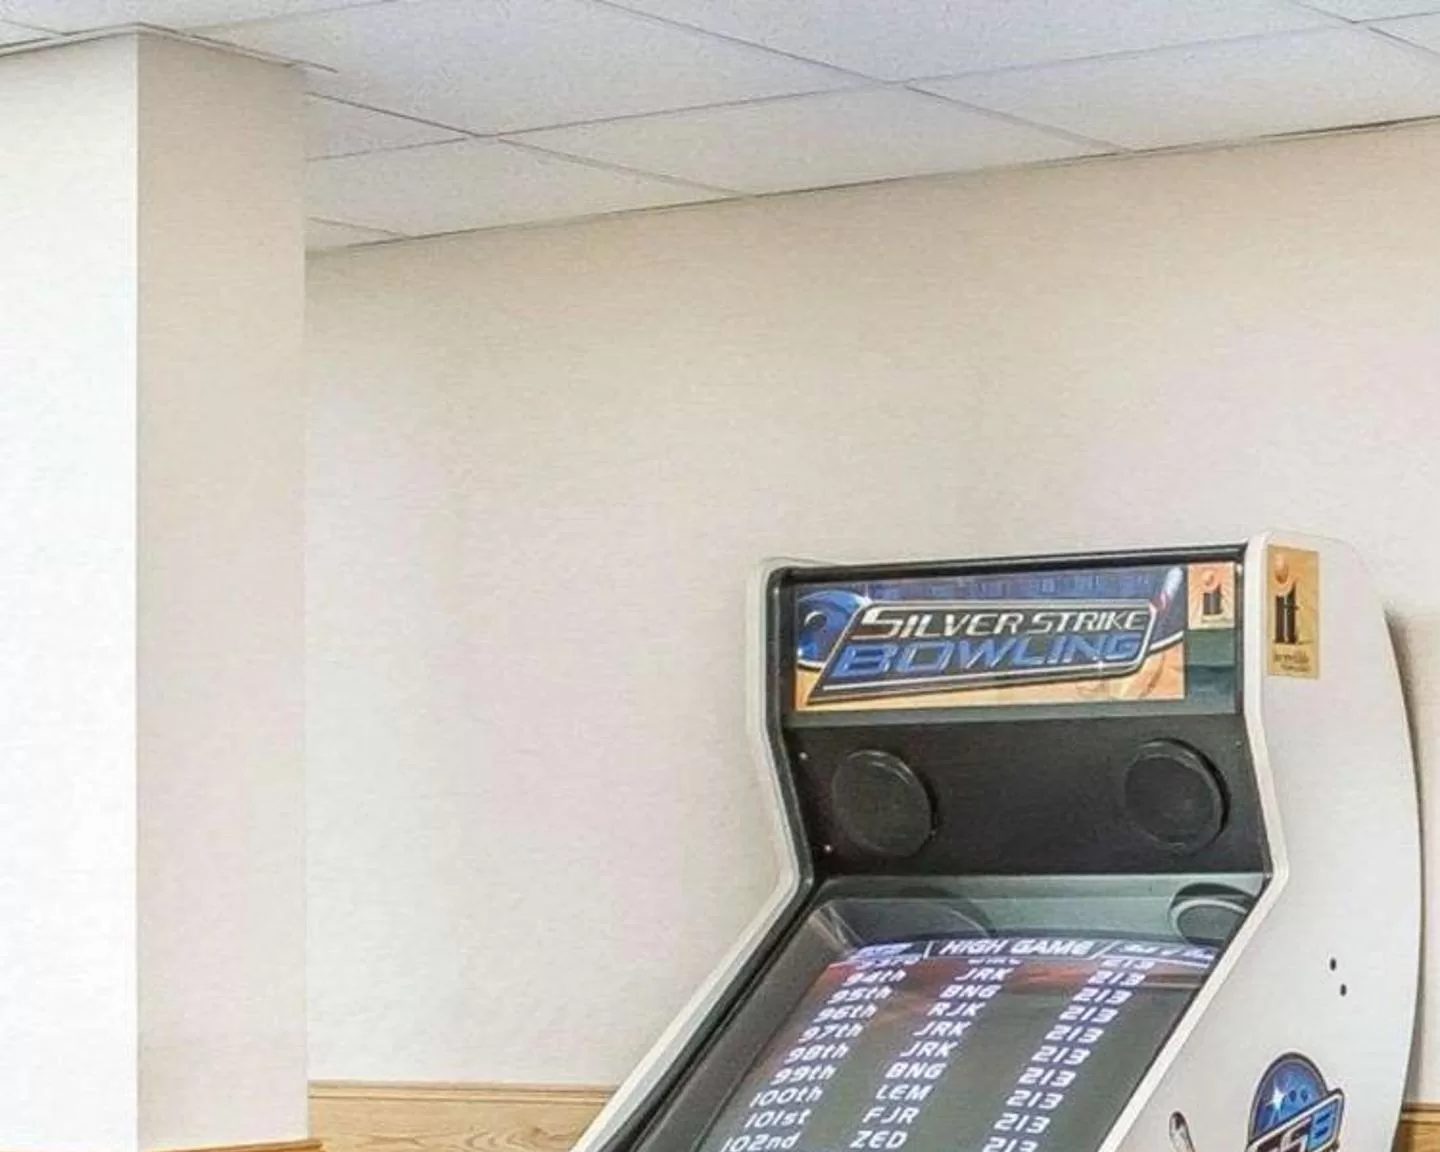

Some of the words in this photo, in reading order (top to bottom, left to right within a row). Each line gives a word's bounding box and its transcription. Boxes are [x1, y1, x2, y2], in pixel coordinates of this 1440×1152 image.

[851, 604, 1026, 640] SILVER
[1027, 610, 1148, 635] STRIKE
[830, 632, 1144, 680] BOWLING
[939, 939, 1009, 955] HIGH
[1010, 939, 1095, 955] GAME
[954, 967, 1014, 981] JRK
[1087, 969, 1146, 986] 213
[939, 984, 1002, 999] BNG
[1071, 987, 1133, 1005] 213
[812, 1003, 878, 1023] 96th
[926, 1001, 986, 1017] RJK
[1058, 1004, 1119, 1023] 213
[797, 1022, 863, 1043] 97th
[912, 1020, 972, 1037] JRK
[1043, 1023, 1104, 1044] 213
[783, 1041, 849, 1064] 98th
[899, 1040, 959, 1057] JRK
[1030, 1045, 1091, 1066] 213
[769, 1064, 837, 1086] 99th
[884, 1061, 948, 1079] BNG
[1017, 1066, 1077, 1088] 213
[748, 1085, 824, 1108] 100th
[875, 1083, 934, 1101] LEM
[1005, 1089, 1064, 1110] 213
[744, 1108, 812, 1129] 101st
[861, 1106, 921, 1125] FJR
[993, 1112, 1052, 1135] 213
[848, 1129, 909, 1150] ZED
